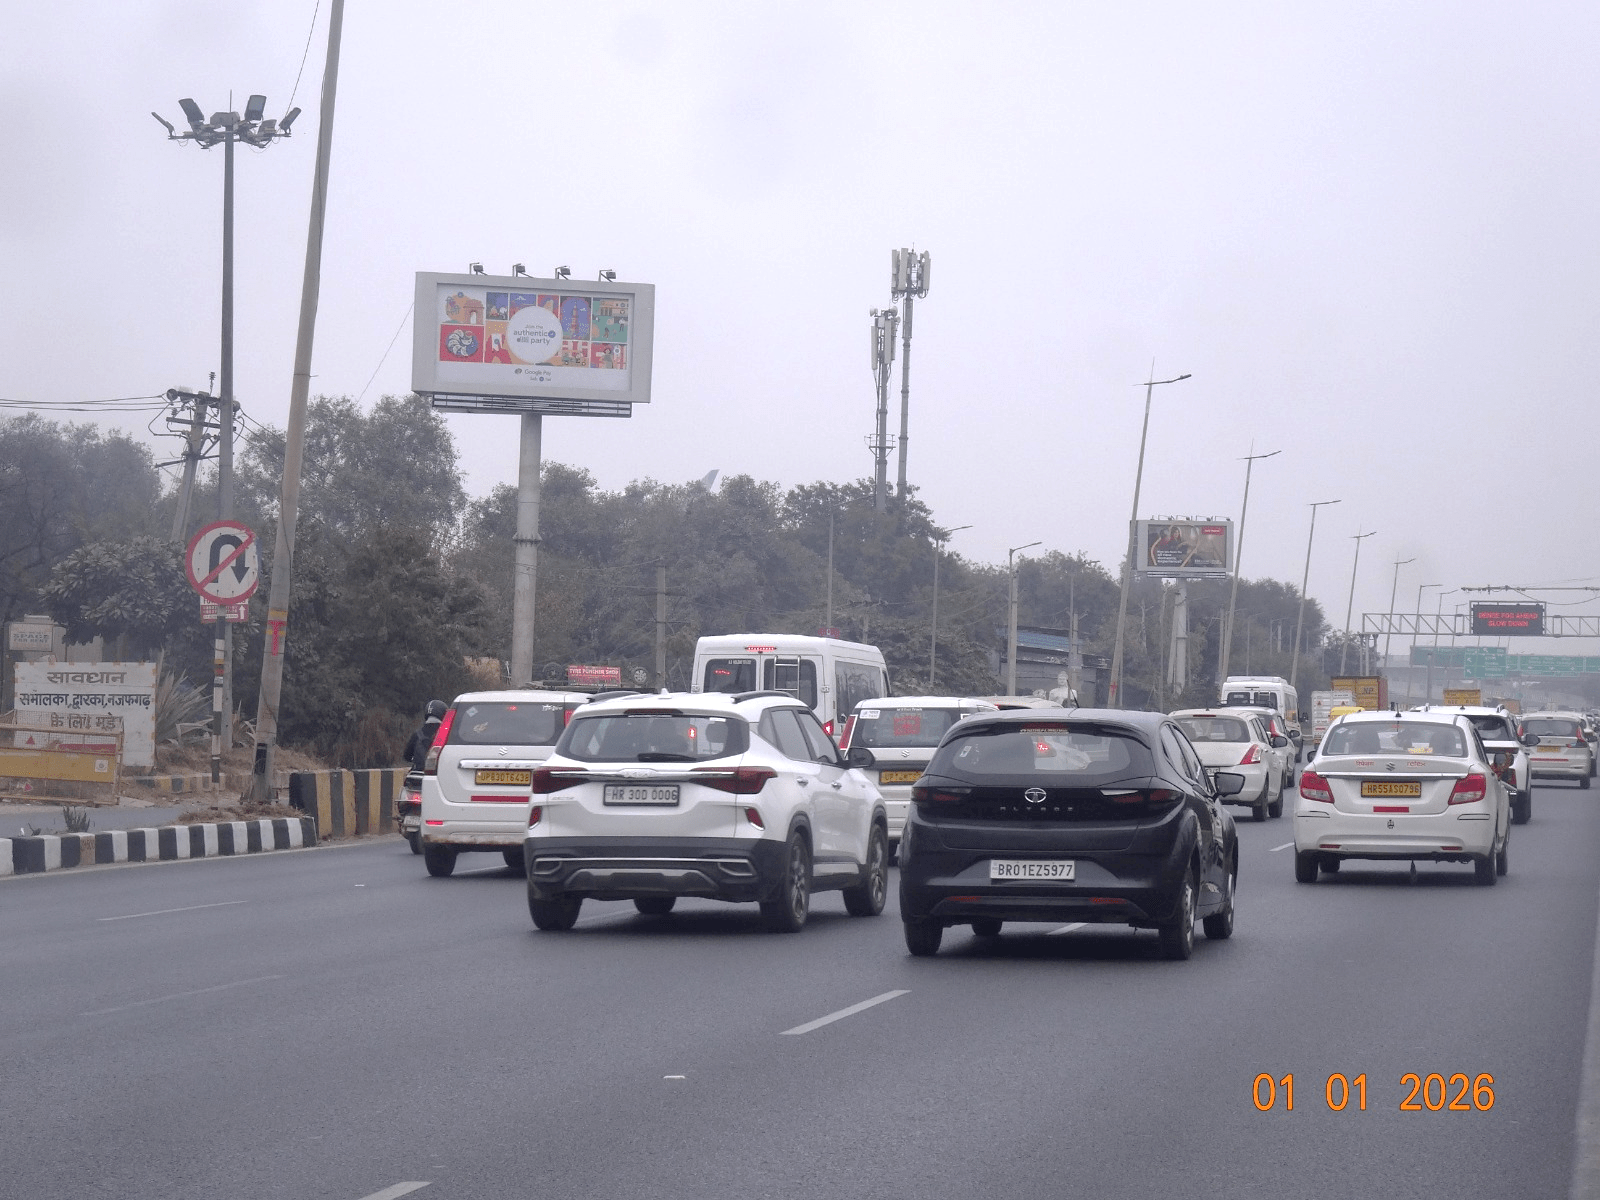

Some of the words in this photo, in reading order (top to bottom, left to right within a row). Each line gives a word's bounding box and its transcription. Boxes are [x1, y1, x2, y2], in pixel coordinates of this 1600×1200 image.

[513, 329, 548, 337] authentic
[530, 337, 550, 346] party
[46, 671, 128, 684] सावधान
[611, 788, 625, 800] HR
[997, 863, 1073, 877] BR01EZ5977
